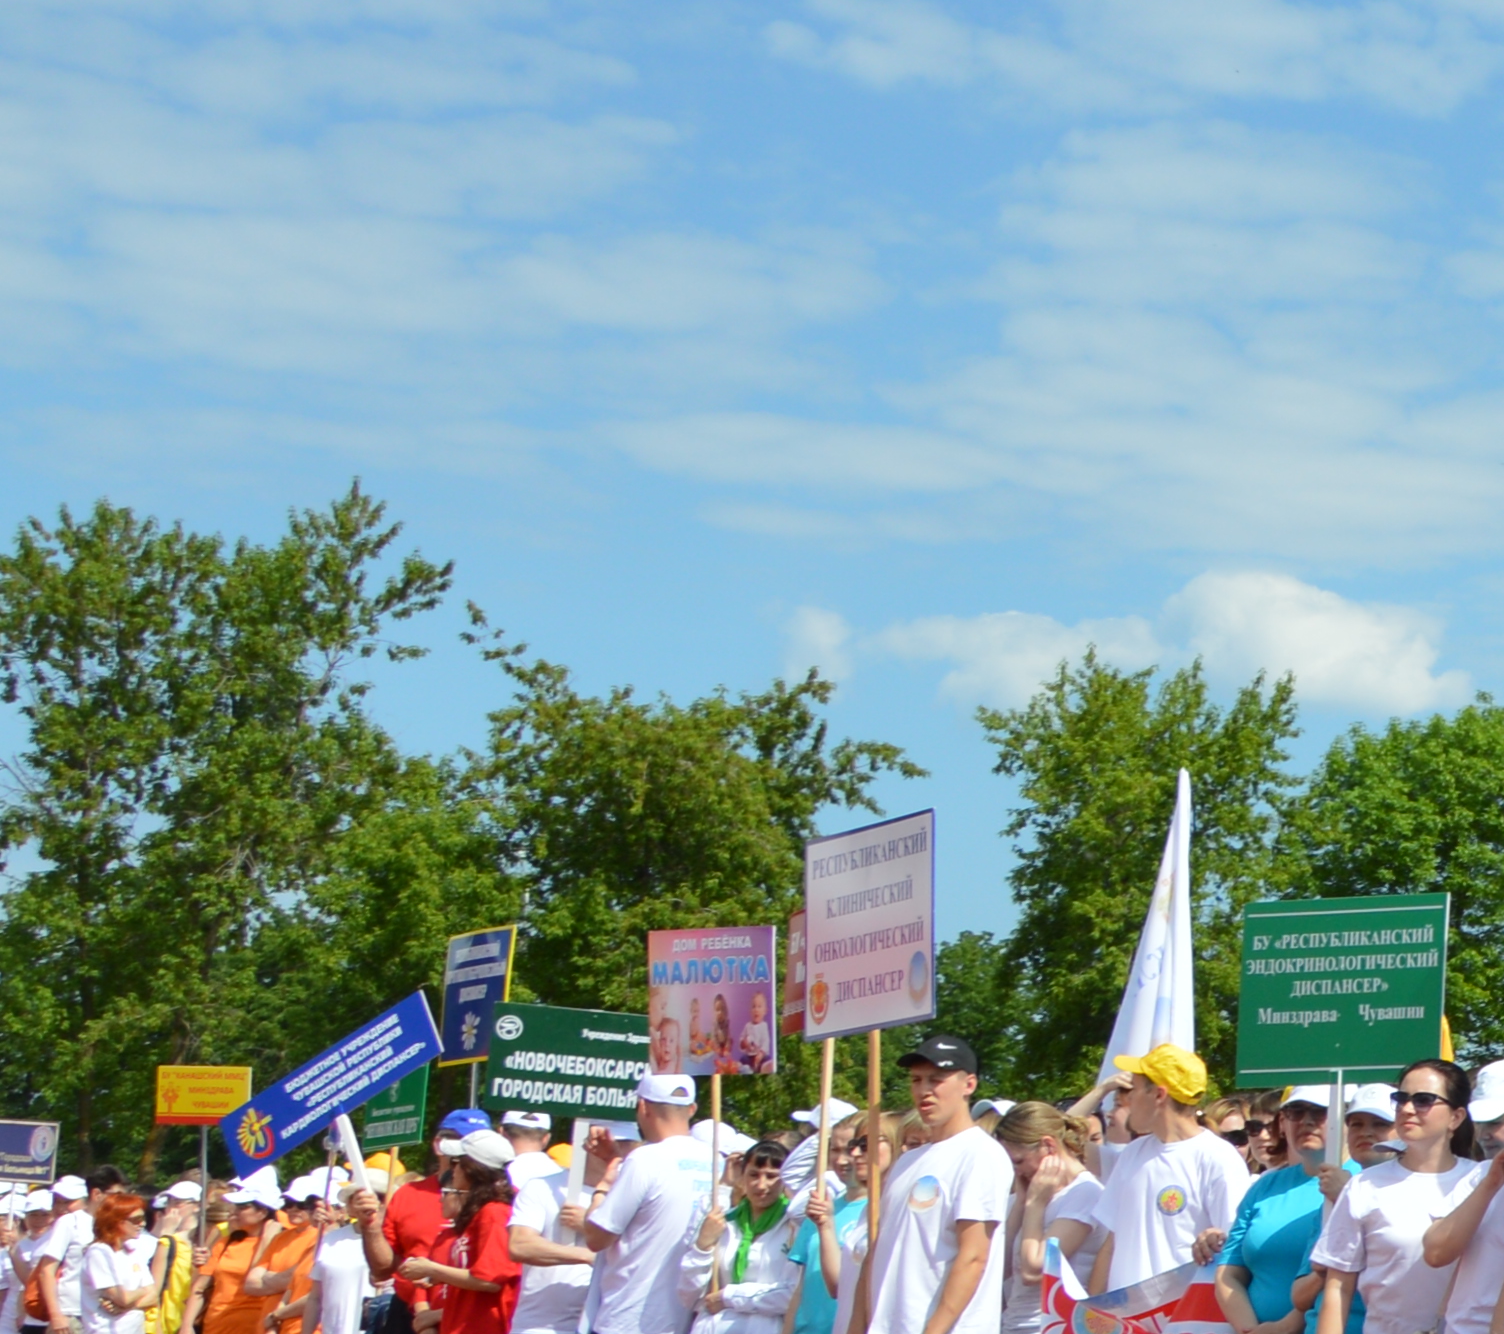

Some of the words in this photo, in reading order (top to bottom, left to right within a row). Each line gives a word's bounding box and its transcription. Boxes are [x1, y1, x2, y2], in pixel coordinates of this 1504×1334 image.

[812, 826, 928, 880] РЕСПУБЛИКАНСКИЙ
[826, 874, 914, 919] КЛИНИЧЕСКИЙ
[672, 938, 697, 953] ДОМ
[701, 934, 752, 950] РЕБЁНКА
[814, 915, 924, 964] ОНКОЛОГИЧЕСКИЙ
[1252, 935, 1272, 951] БУ
[1274, 924, 1434, 950] «РЕСПУБЛИКАНСКИЙ
[652, 954, 770, 988] МАЛЮТКА
[1245, 948, 1439, 976] ЭНДОКРИНОЛОГИЧЕСКИЙ
[834, 969, 905, 1004] ДИСПАНСЕР
[1289, 977, 1389, 998] ДИСПАНСЕР»
[1358, 1004, 1425, 1027] Чувашии
[491, 1077, 583, 1105] ГОРОДСКАЯ
